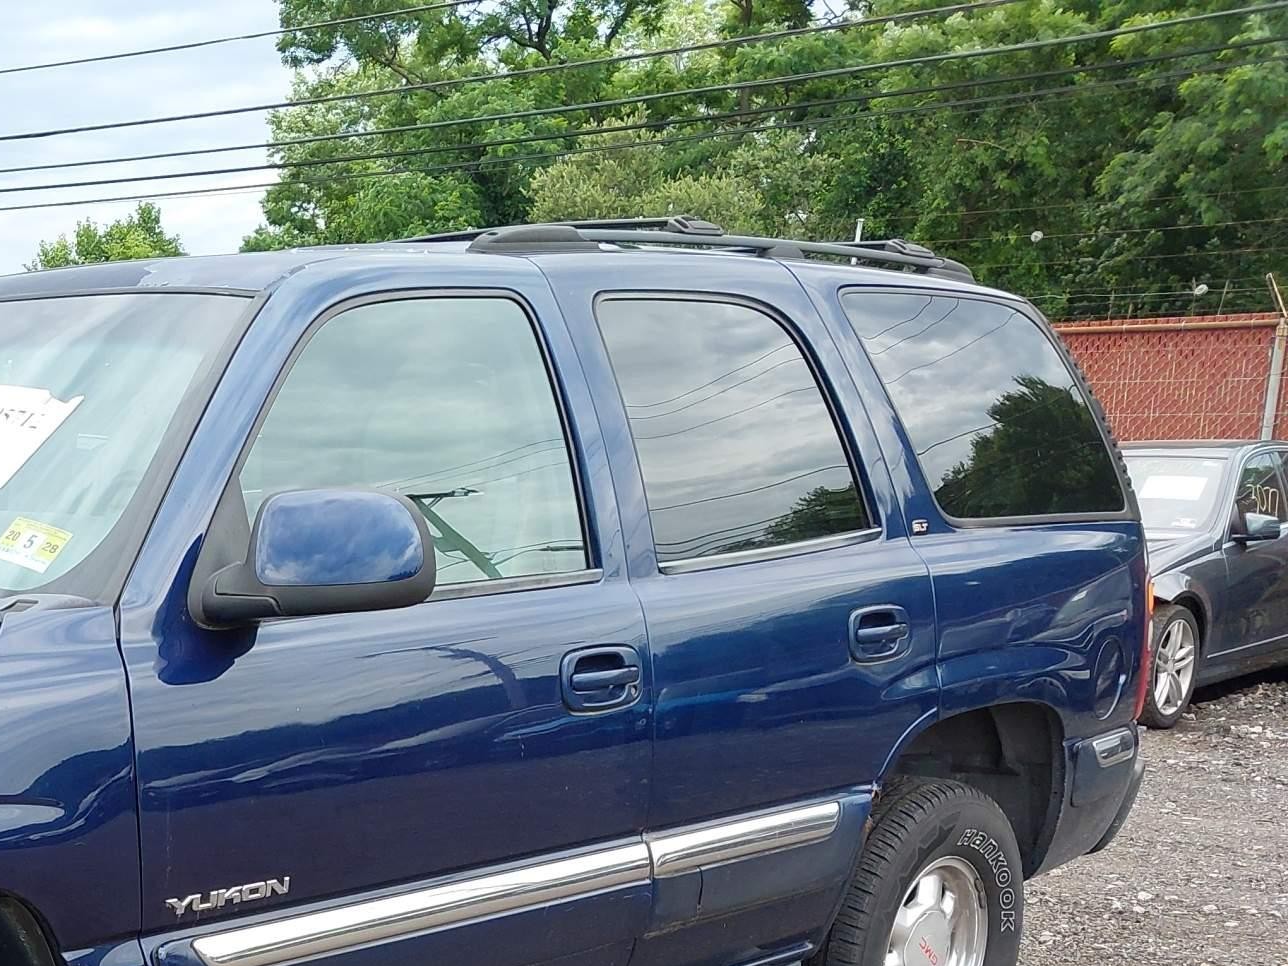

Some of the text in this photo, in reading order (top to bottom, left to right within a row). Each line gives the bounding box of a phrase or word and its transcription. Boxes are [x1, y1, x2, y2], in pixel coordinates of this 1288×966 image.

[5, 529, 21, 541] 20
[23, 534, 38, 549] 5
[41, 541, 59, 554] 28
[165, 876, 290, 915] YUKON
[919, 936, 938, 966] GMC
